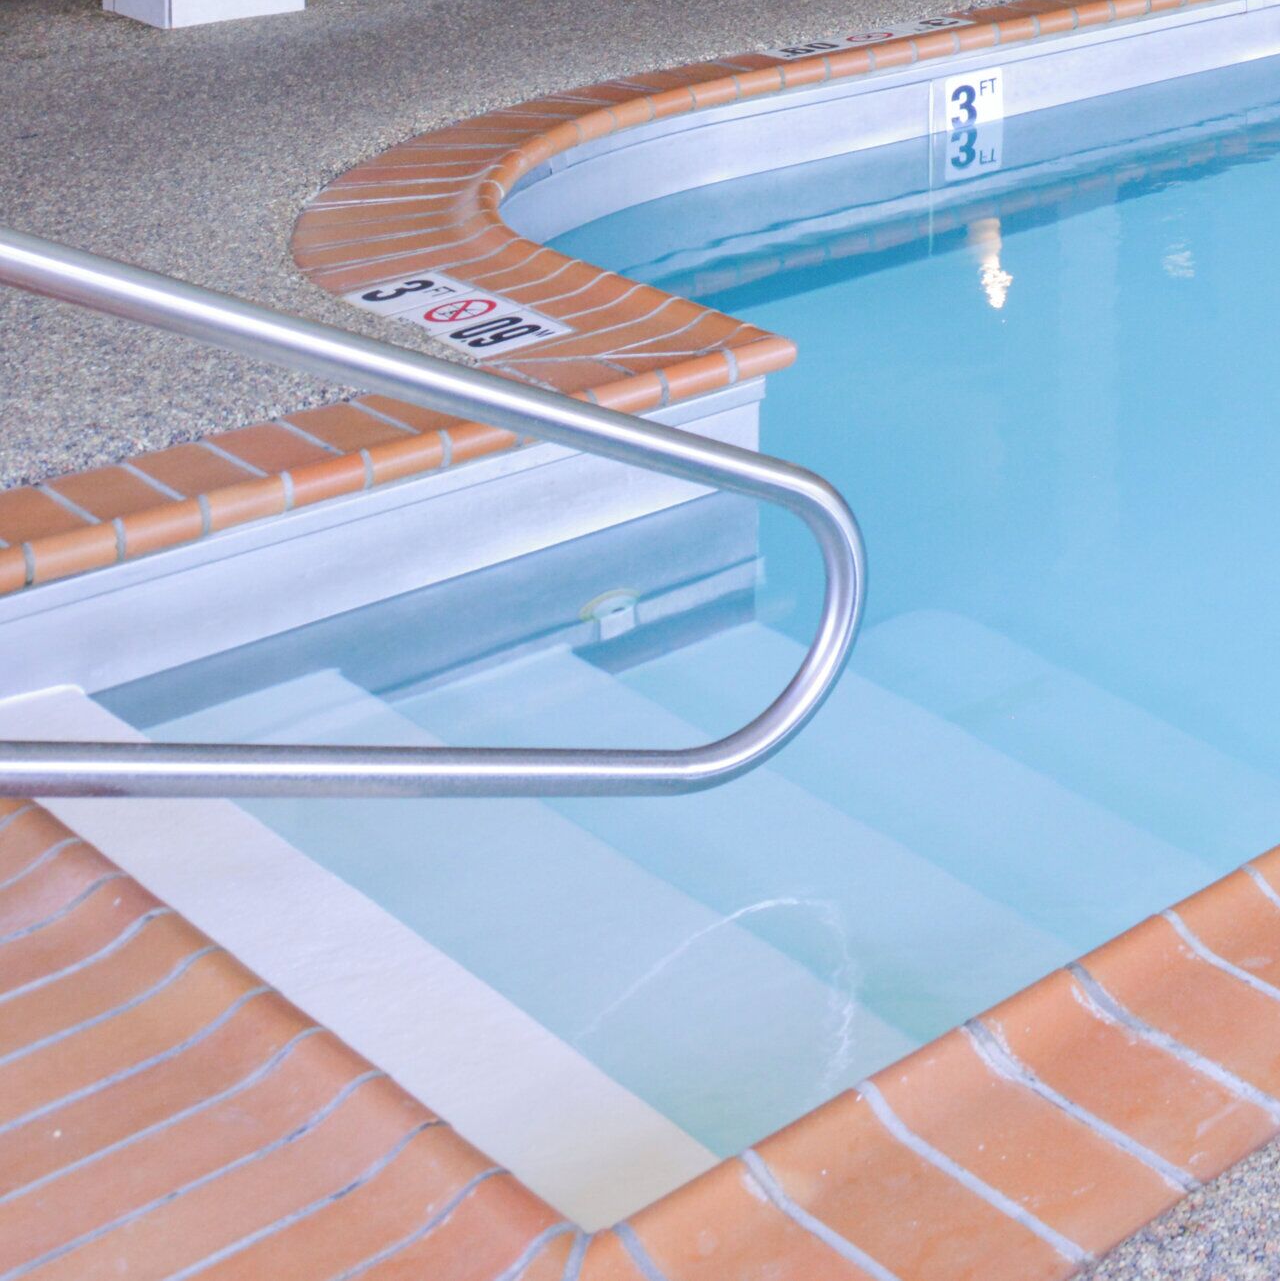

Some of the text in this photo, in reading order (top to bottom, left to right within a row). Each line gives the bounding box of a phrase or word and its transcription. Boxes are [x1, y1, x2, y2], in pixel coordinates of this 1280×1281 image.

[950, 77, 997, 128] 3 FT
[361, 279, 456, 302] 3 FT
